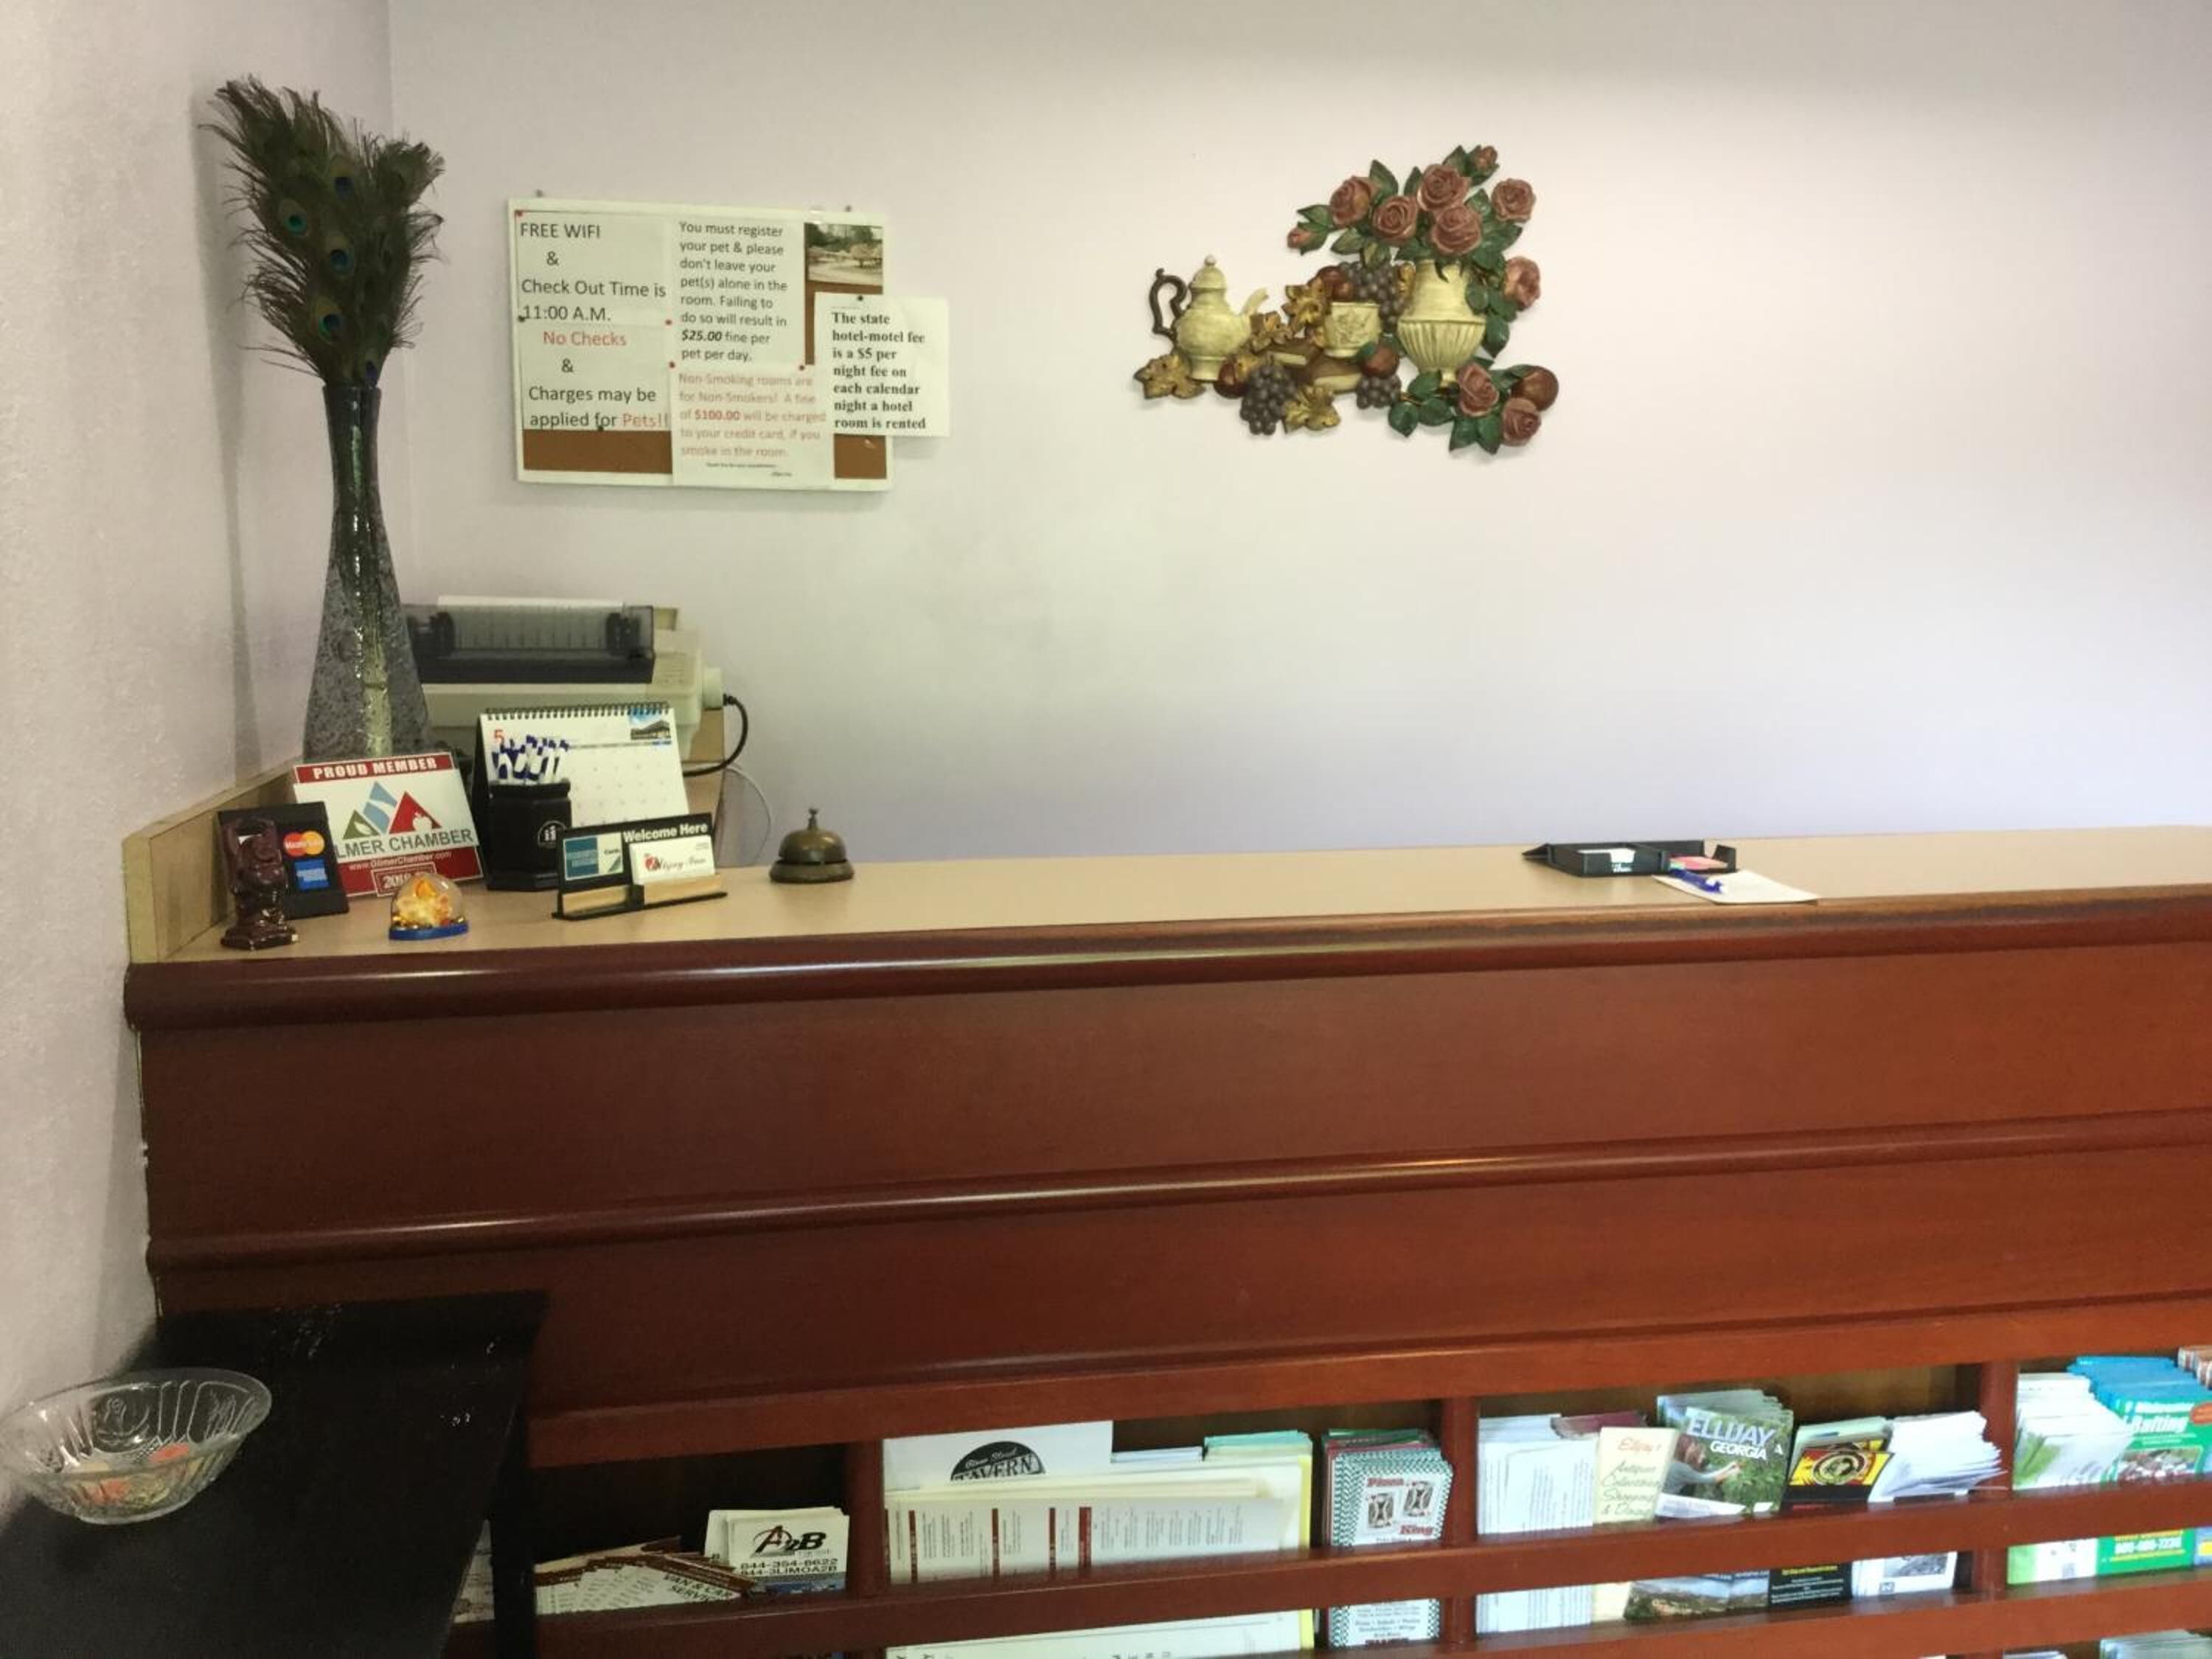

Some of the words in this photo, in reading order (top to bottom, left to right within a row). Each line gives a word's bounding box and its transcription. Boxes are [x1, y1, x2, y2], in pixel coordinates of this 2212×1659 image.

[520, 223, 558, 237] FREE
[564, 224, 601, 239] WIFI
[679, 221, 701, 234] You
[706, 223, 734, 234] must
[738, 225, 783, 238] register
[680, 242, 706, 253] your
[710, 243, 730, 254] pet
[734, 242, 742, 253] &
[747, 244, 784, 256] please
[546, 251, 559, 266] &
[680, 259, 712, 270] don't
[714, 260, 745, 271] leave
[749, 262, 776, 274] your
[521, 279, 570, 295] Check
[574, 280, 605, 296] Out
[610, 282, 649, 296] Time
[654, 282, 666, 297] is
[680, 276, 714, 290] pet(s)
[718, 278, 750, 289] alone
[754, 279, 765, 290] in
[768, 280, 787, 291] the
[681, 296, 715, 306] room.
[720, 296, 757, 310] Failing
[760, 298, 773, 308] to
[524, 306, 568, 321] 11:00
[573, 307, 611, 321] A.M.
[681, 312, 697, 323] do
[699, 314, 713, 324] so
[717, 313, 737, 324] will
[740, 315, 773, 327] result
[776, 316, 787, 327] in
[832, 312, 856, 324] The
[860, 313, 890, 324] state
[543, 331, 566, 345] No
[571, 331, 627, 347] Checks
[681, 330, 723, 341] $25.00
[725, 331, 747, 343] fine
[751, 335, 770, 346] per
[832, 330, 903, 342] hotel-motel
[908, 332, 925, 343] fee
[681, 348, 702, 360] pet
[704, 350, 724, 362] per
[728, 349, 752, 363] day.
[832, 347, 843, 359] is
[847, 351, 853, 359] a
[858, 347, 872, 359] $5
[876, 349, 897, 362] per
[561, 358, 574, 372] &
[833, 366, 866, 379] night
[870, 365, 888, 377] fee
[891, 369, 906, 378] on
[757, 376, 792, 386] rooms
[833, 383, 862, 394] each
[866, 383, 920, 394] calendar
[529, 386, 593, 404] Charges
[598, 390, 631, 405] may
[637, 388, 656, 402] be
[834, 400, 866, 413] night
[871, 403, 878, 411] a
[882, 400, 913, 412] hotel
[530, 413, 589, 429] applied
[594, 413, 617, 427] for
[680, 410, 692, 420] of
[695, 410, 740, 422] $100.00
[743, 411, 762, 421] will
[765, 411, 779, 421] be
[782, 412, 826, 424] charged
[835, 419, 868, 428] room
[872, 417, 882, 428] is
[886, 417, 926, 429] rented
[695, 430, 720, 440] your
[724, 429, 755, 439] credit
[313, 763, 368, 779] PROUD
[372, 757, 437, 774] MEMBER
[623, 826, 678, 842] Welcome
[679, 823, 709, 835] Here
[335, 839, 383, 858] LMER
[389, 829, 473, 852] CHAMBER
[1710, 1440, 1767, 1461] GEORGIA
